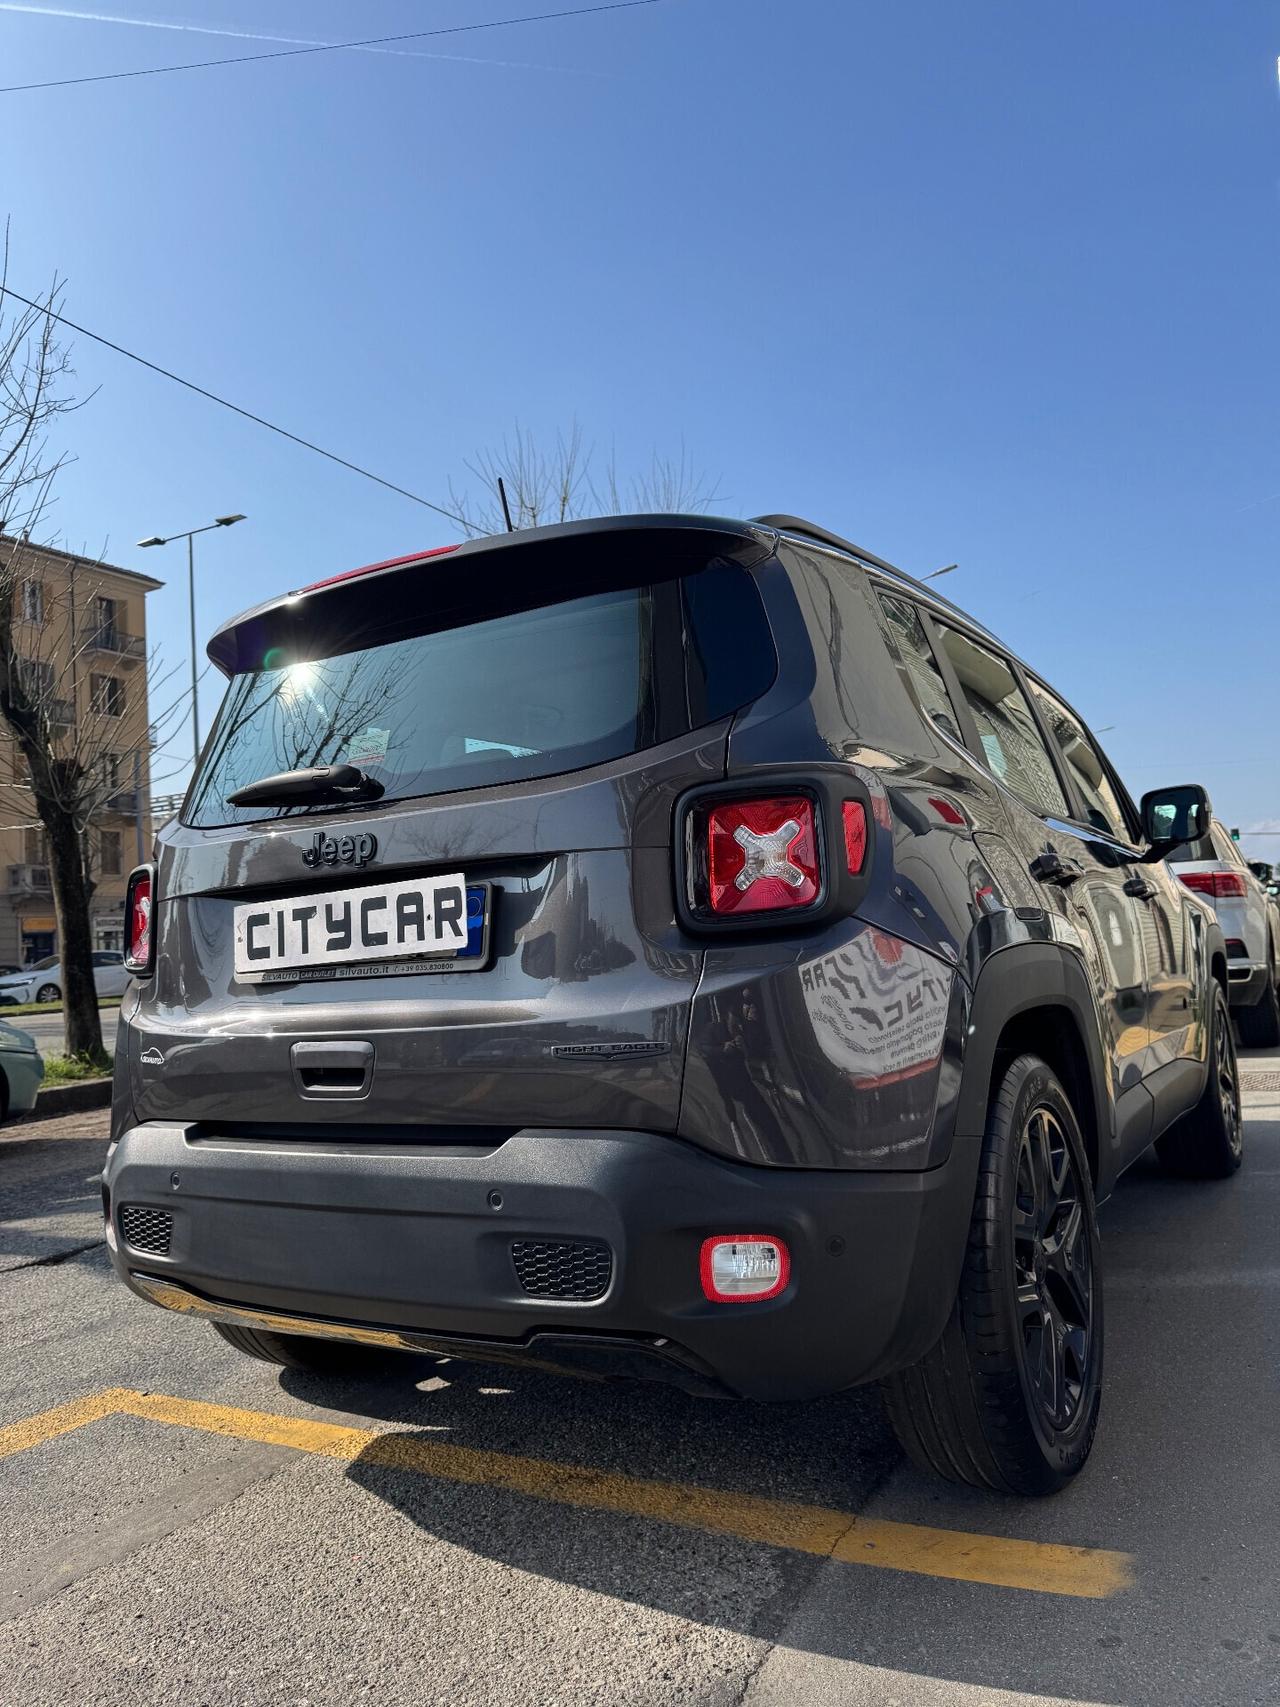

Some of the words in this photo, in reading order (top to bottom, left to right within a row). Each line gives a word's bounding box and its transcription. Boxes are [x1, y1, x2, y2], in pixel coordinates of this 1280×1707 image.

[302, 831, 378, 868] Jeep
[246, 886, 464, 961] CITYCAR
[339, 965, 389, 977] silvauto.it
[555, 1045, 603, 1055] NIGHT
